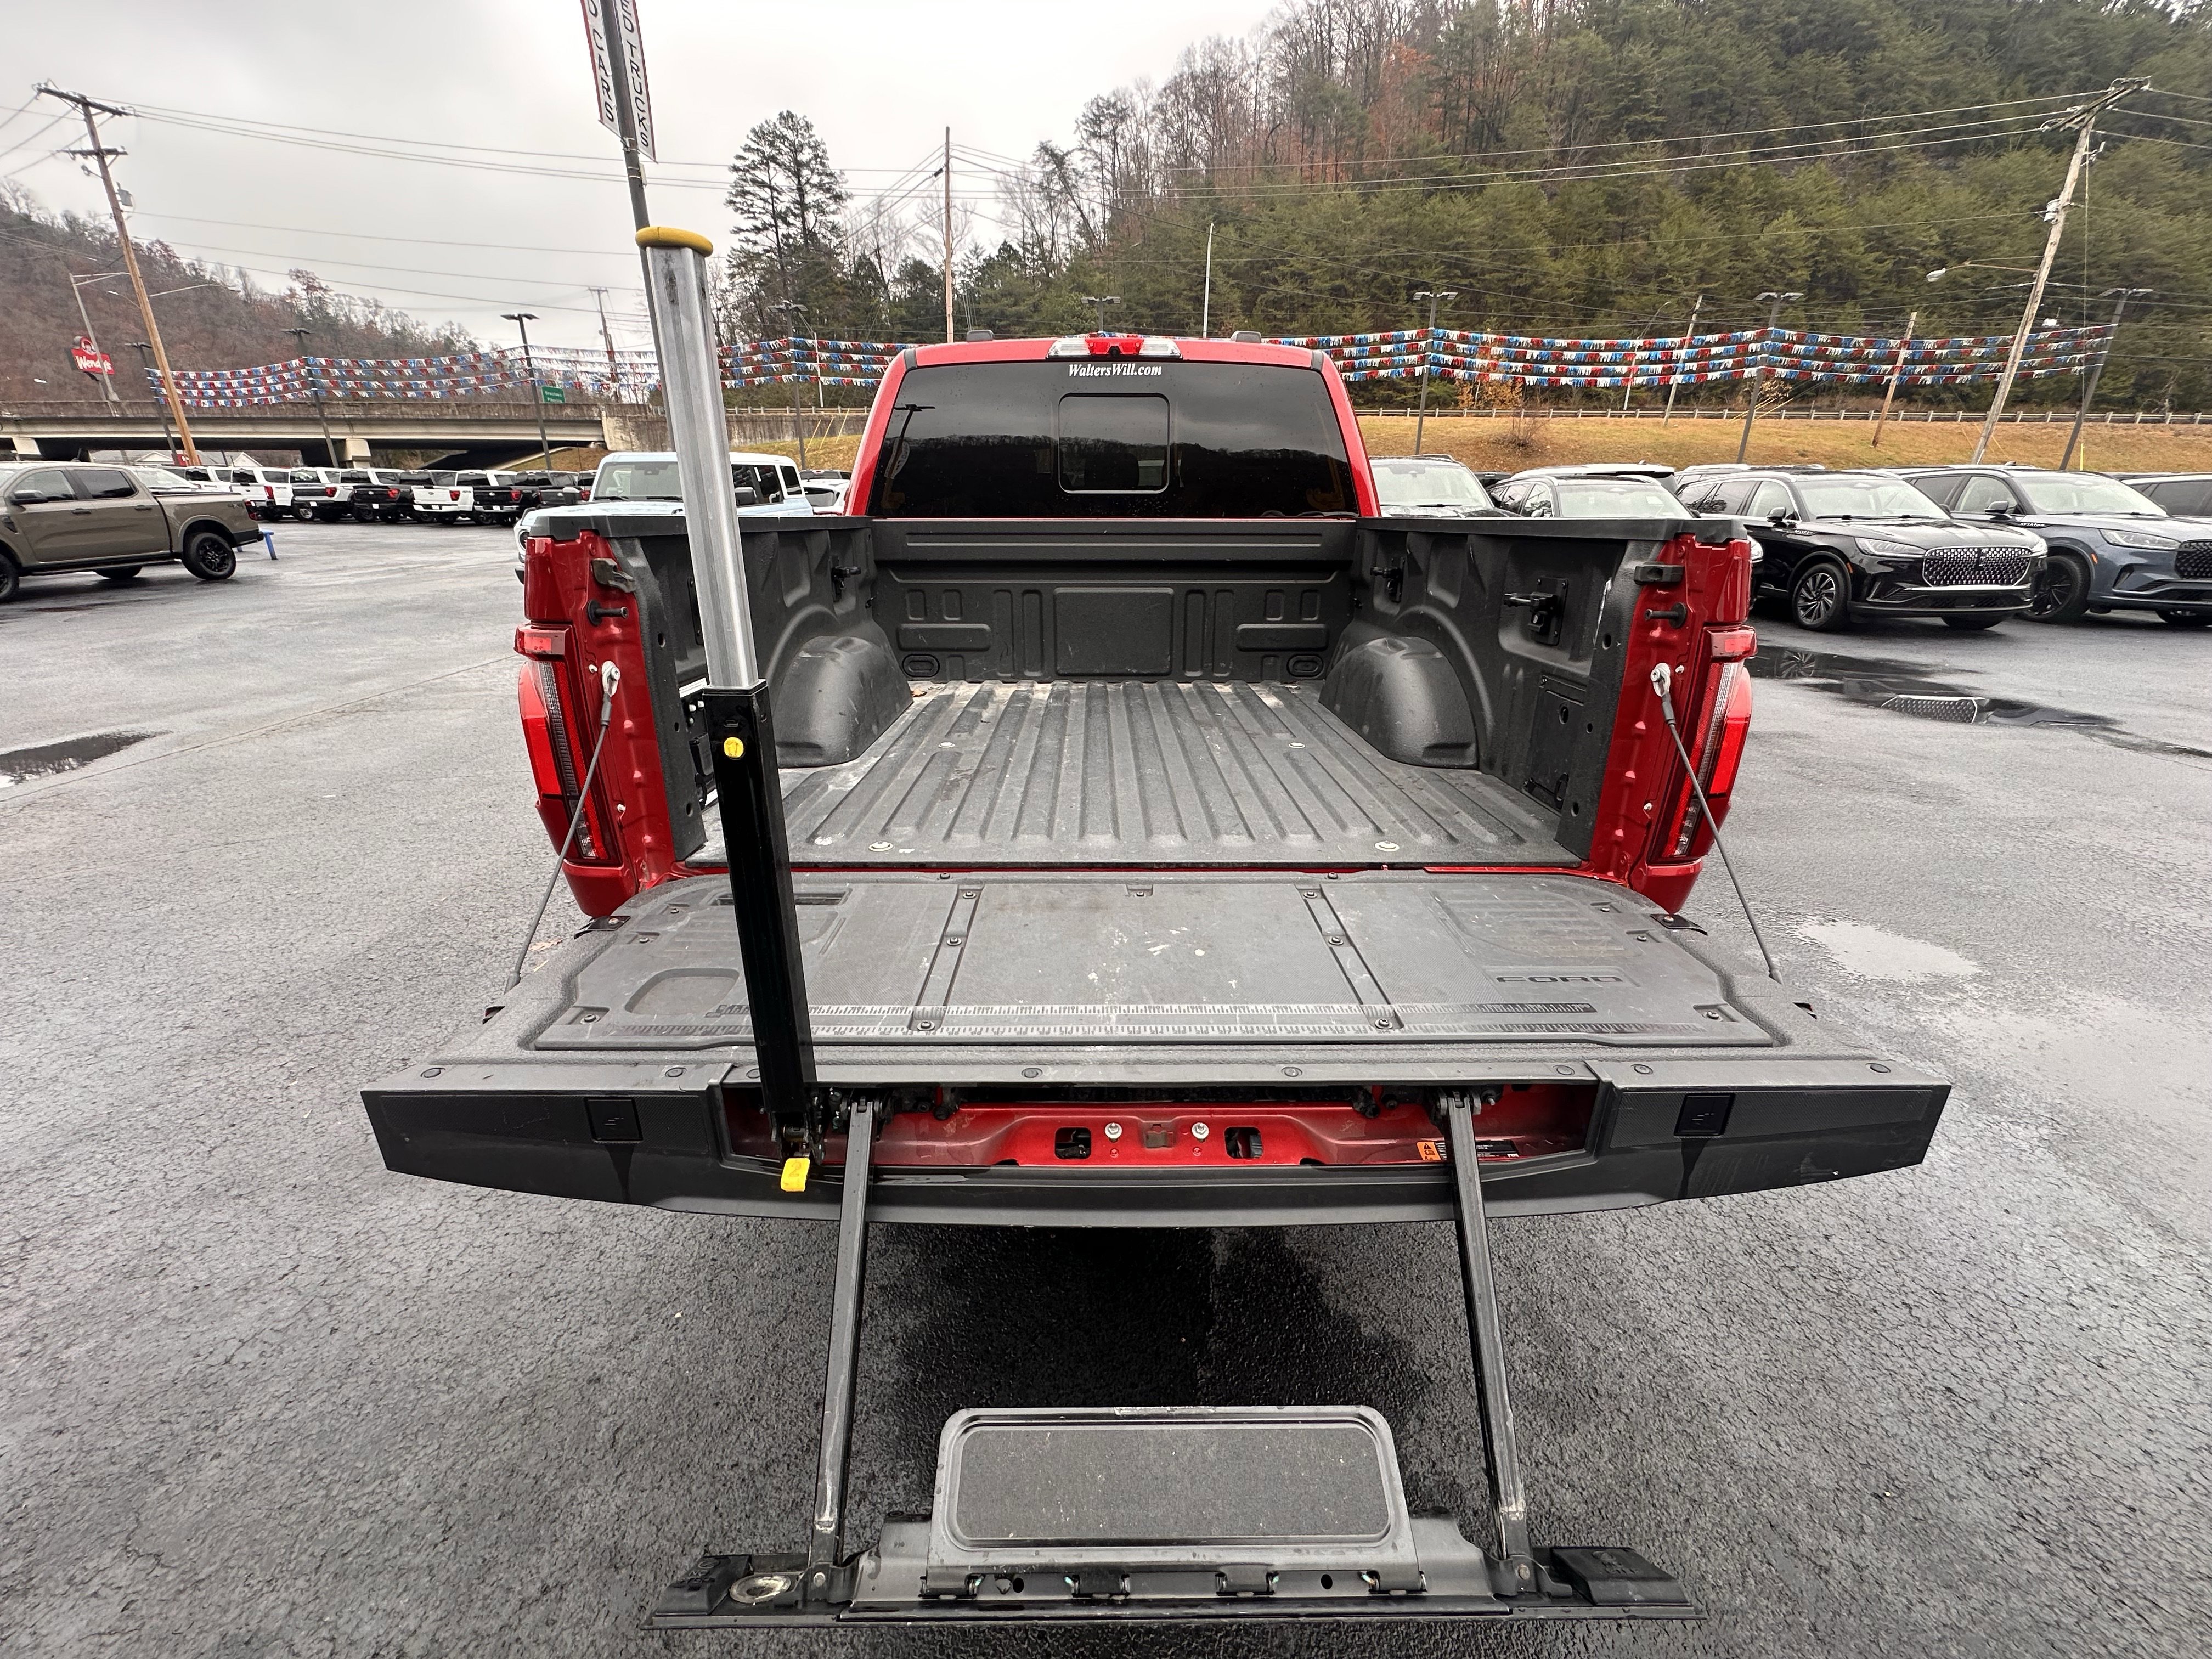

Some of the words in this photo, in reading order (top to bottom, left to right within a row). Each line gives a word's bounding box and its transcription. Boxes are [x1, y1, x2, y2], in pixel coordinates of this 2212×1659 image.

[592, 28, 614, 122] CARS
[627, 40, 649, 148] TRUCKS
[1069, 363, 1162, 377] WaltersWill.com
